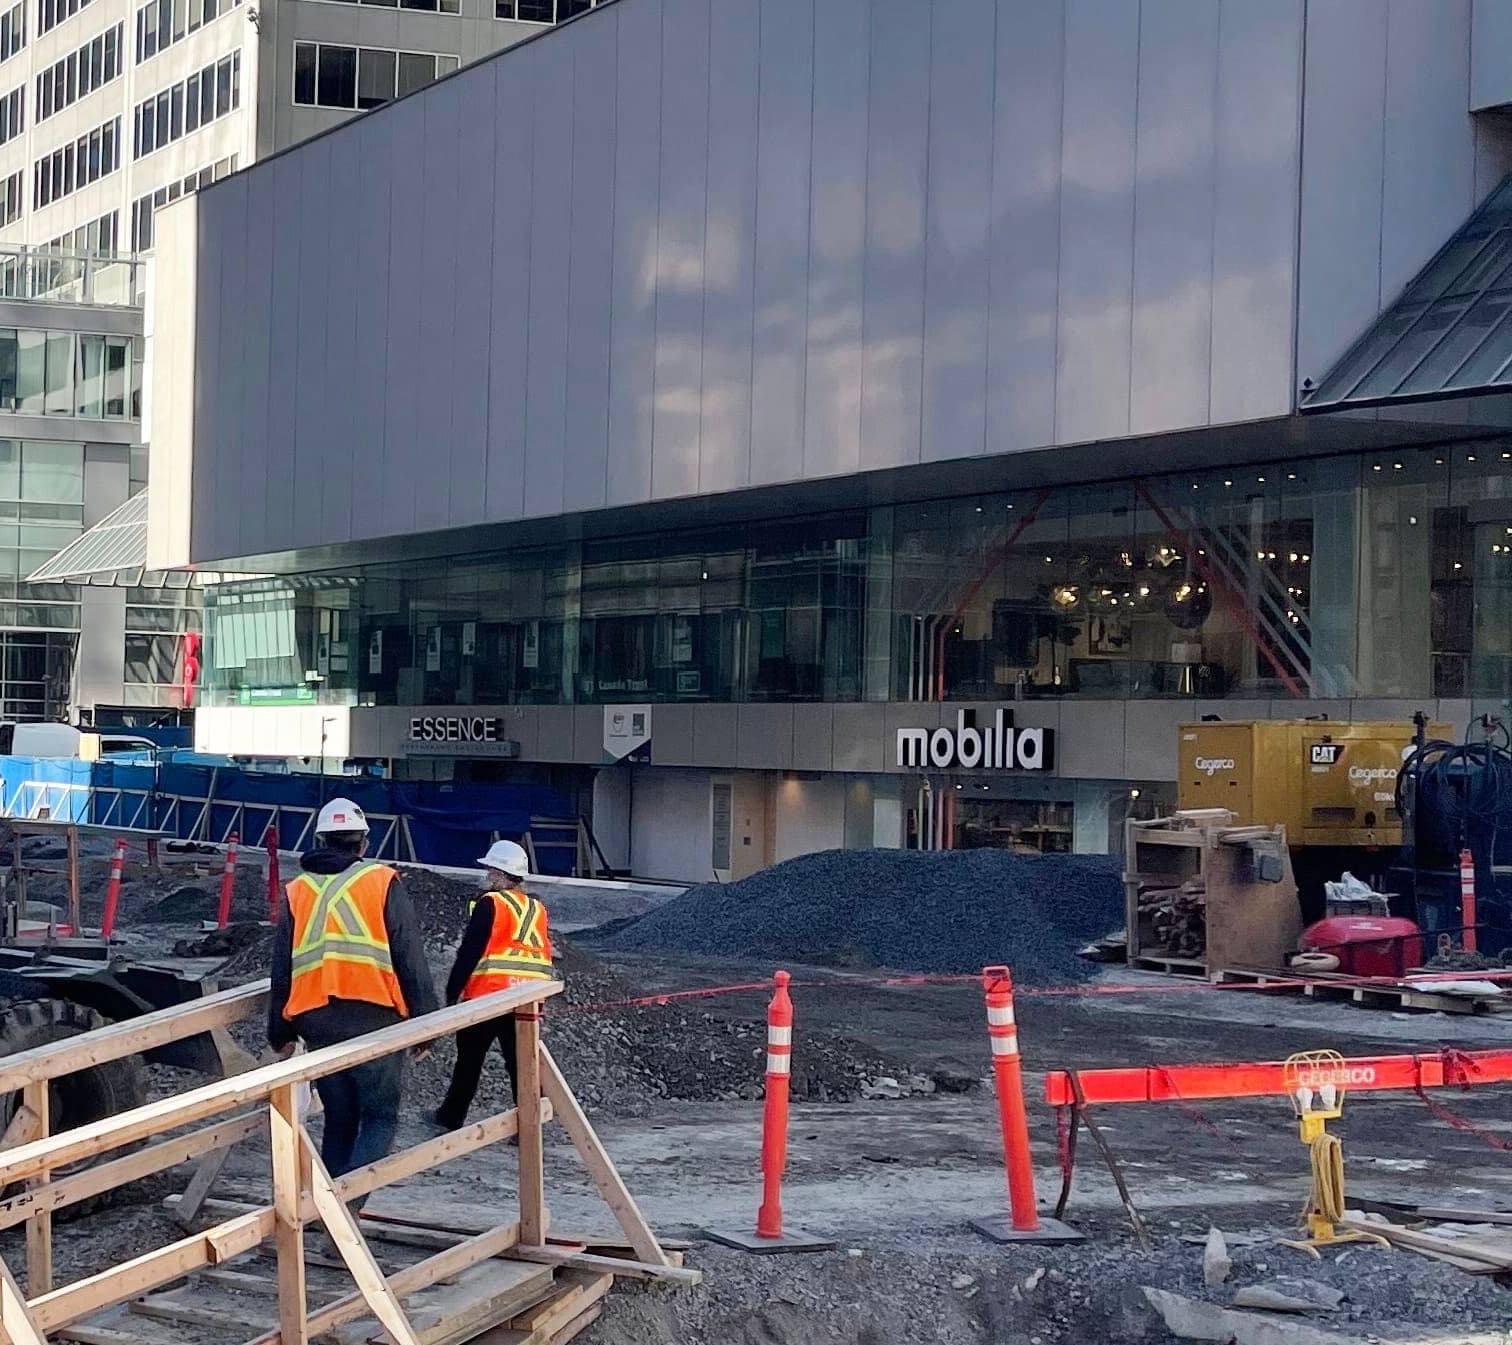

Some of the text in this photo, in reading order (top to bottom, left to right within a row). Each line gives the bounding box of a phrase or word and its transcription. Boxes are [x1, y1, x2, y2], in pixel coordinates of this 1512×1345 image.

[410, 716, 497, 742] ESSENCE
[896, 709, 1044, 769] mobilia
[1312, 746, 1337, 763] CAT
